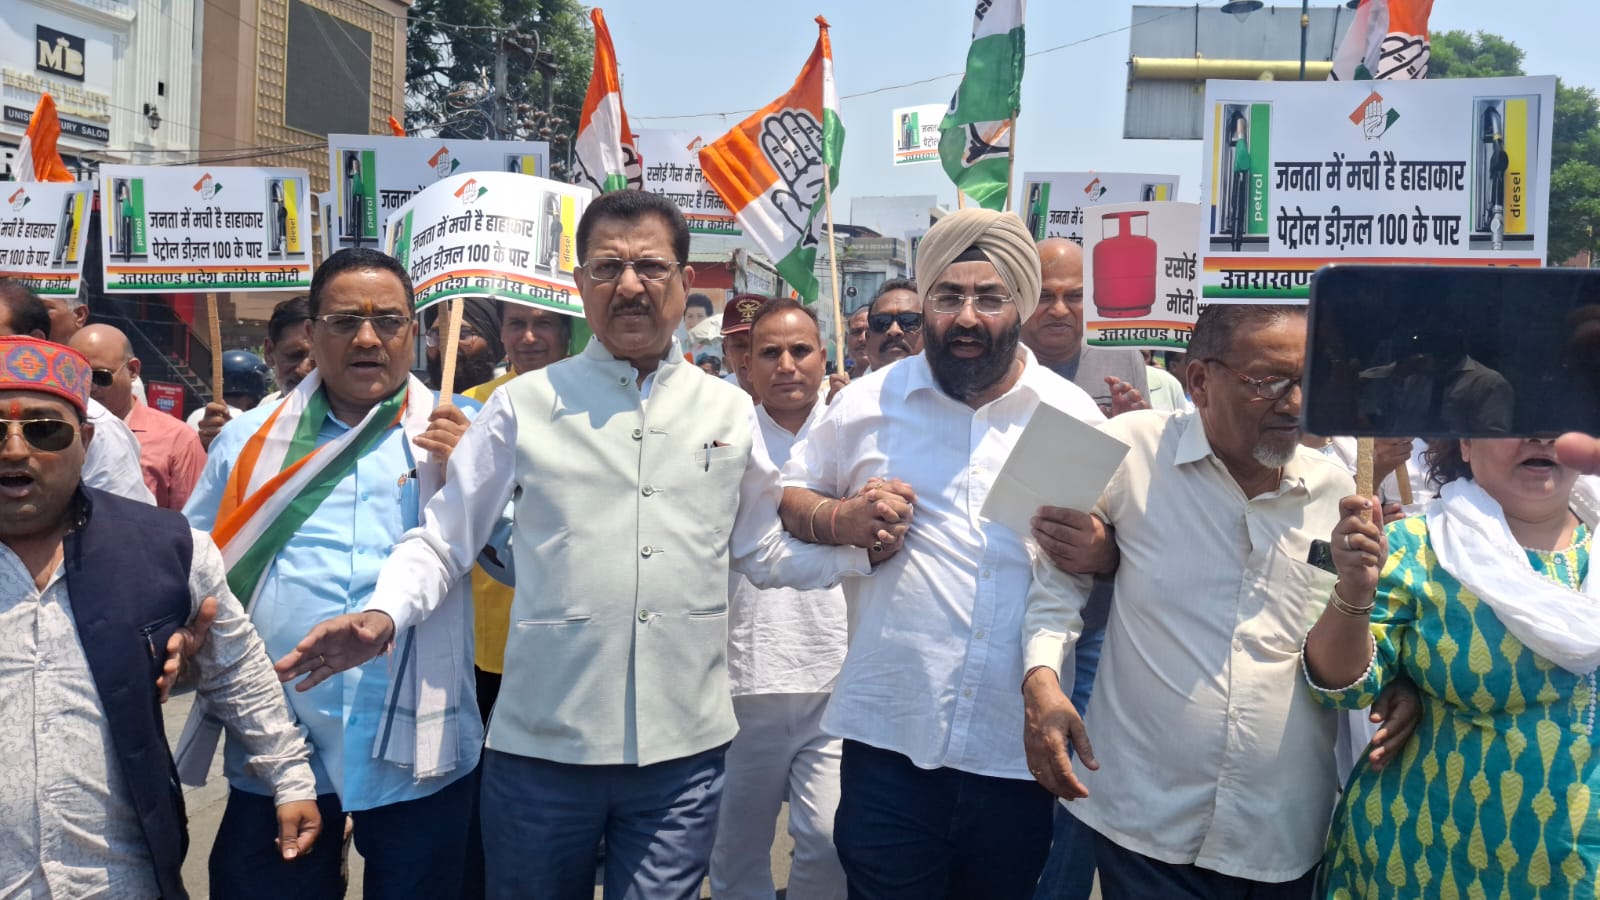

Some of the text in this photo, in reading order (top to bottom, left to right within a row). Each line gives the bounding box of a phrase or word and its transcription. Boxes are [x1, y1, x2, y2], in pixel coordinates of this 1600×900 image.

[38, 39, 84, 76] MB
[81, 126, 108, 139] SALON
[647, 162, 668, 183] रसोई
[669, 163, 683, 182] गैस
[685, 164, 699, 182] में
[1275, 151, 1466, 191] जनता में मची है हाहाकार
[696, 189, 703, 209] है
[1253, 173, 1264, 222] petrol
[1510, 171, 1521, 218] diesel
[149, 206, 263, 228] जनता में मची है हाहाकार
[366, 196, 375, 229] petrol
[1049, 209, 1070, 225] जनता
[18, 217, 25, 238] है
[25, 222, 57, 239] हाहाकार
[135, 217, 144, 246] petrol
[412, 225, 436, 252] जनता
[437, 215, 450, 238] में
[449, 210, 472, 233] मची
[474, 209, 484, 231] है
[485, 214, 534, 238] हाहाकार
[1277, 205, 1461, 251] पेट्रोल डीज़ल 100 के पार
[9, 249, 25, 265] 100
[26, 245, 36, 266] के
[36, 250, 50, 267] पार
[152, 236, 262, 262] पेट्रोल डीज़ल 100 के पार
[411, 253, 433, 281] पेट्रोल
[434, 245, 465, 270] डीज़ल
[467, 244, 490, 263] 100
[493, 240, 507, 263] के
[509, 247, 530, 268] पार
[563, 235, 572, 263] diesel
[118, 267, 300, 286] उत्तराखण्ड प्रदेश कांग्रेस कमेटी
[1164, 252, 1197, 281] रसोई
[44, 275, 72, 291] कमेटी
[474, 274, 525, 295] कांग्रेस
[528, 284, 572, 305] कमेटी
[1166, 288, 1195, 316] मोदी
[1098, 327, 1171, 342] उत्तराखण्ड
